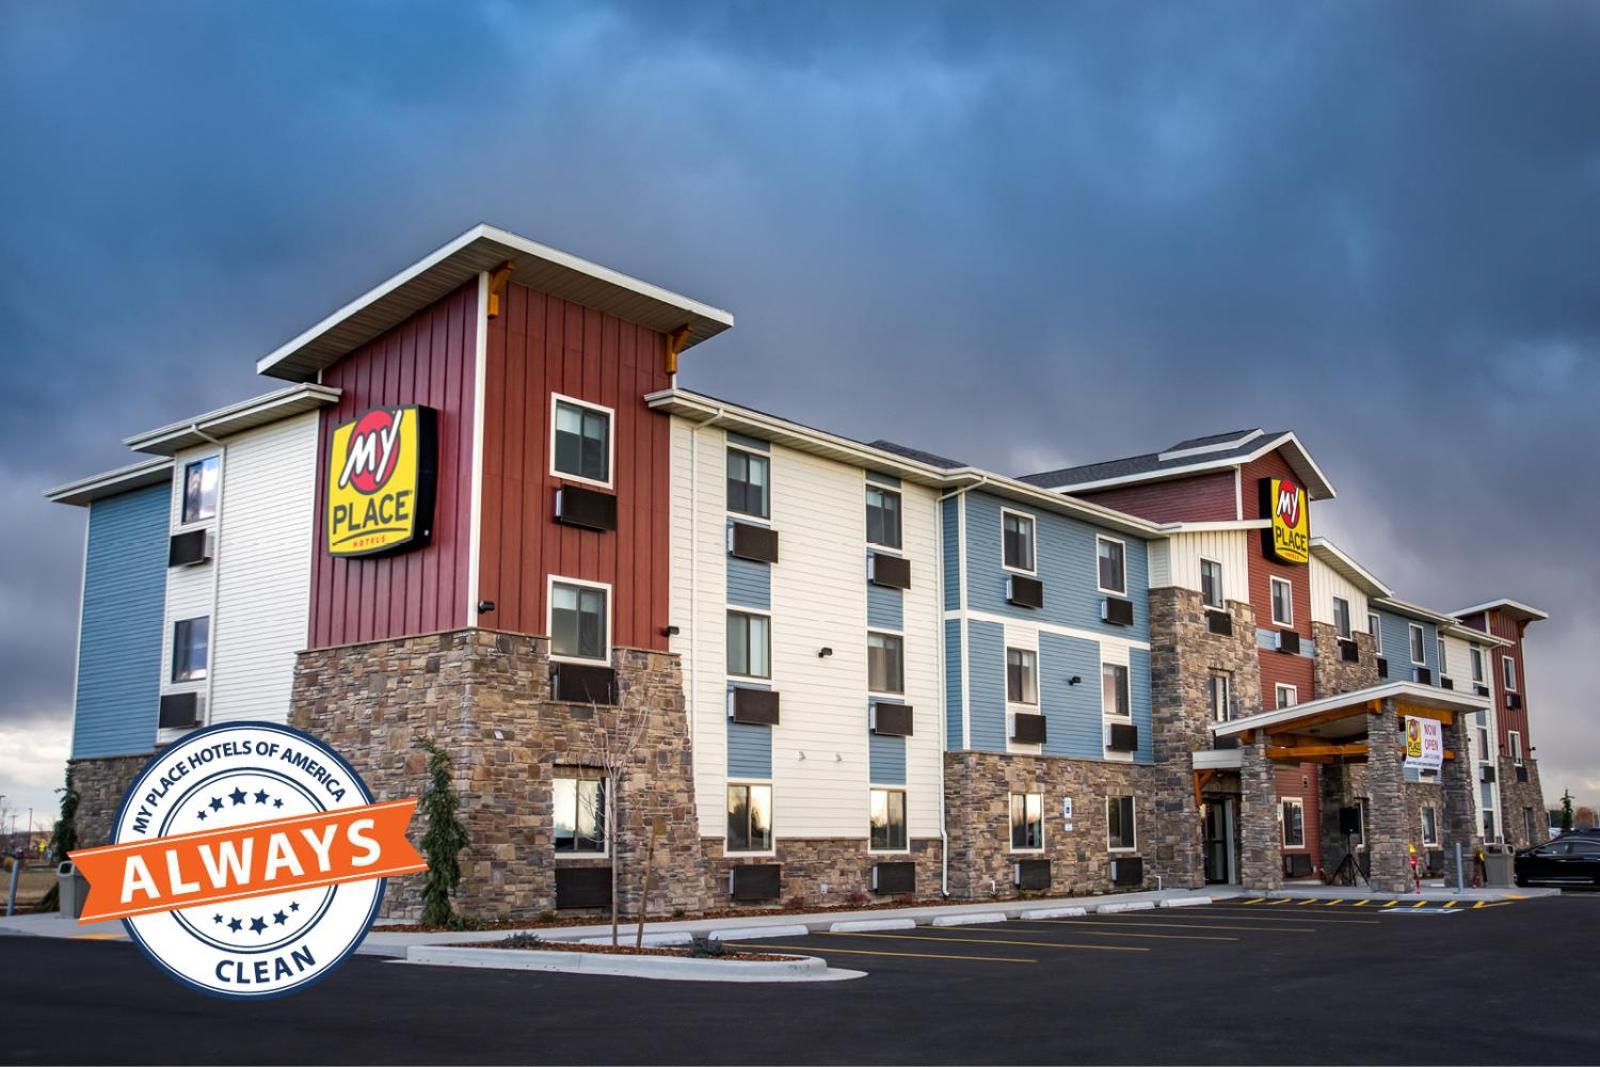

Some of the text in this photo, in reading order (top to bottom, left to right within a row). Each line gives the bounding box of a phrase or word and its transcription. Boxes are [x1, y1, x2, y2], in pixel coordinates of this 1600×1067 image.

[332, 490, 410, 535] PLACE
[352, 536, 387, 548] HOTELS
[1275, 526, 1307, 552] PLACE
[1424, 738, 1439, 751] OPEN
